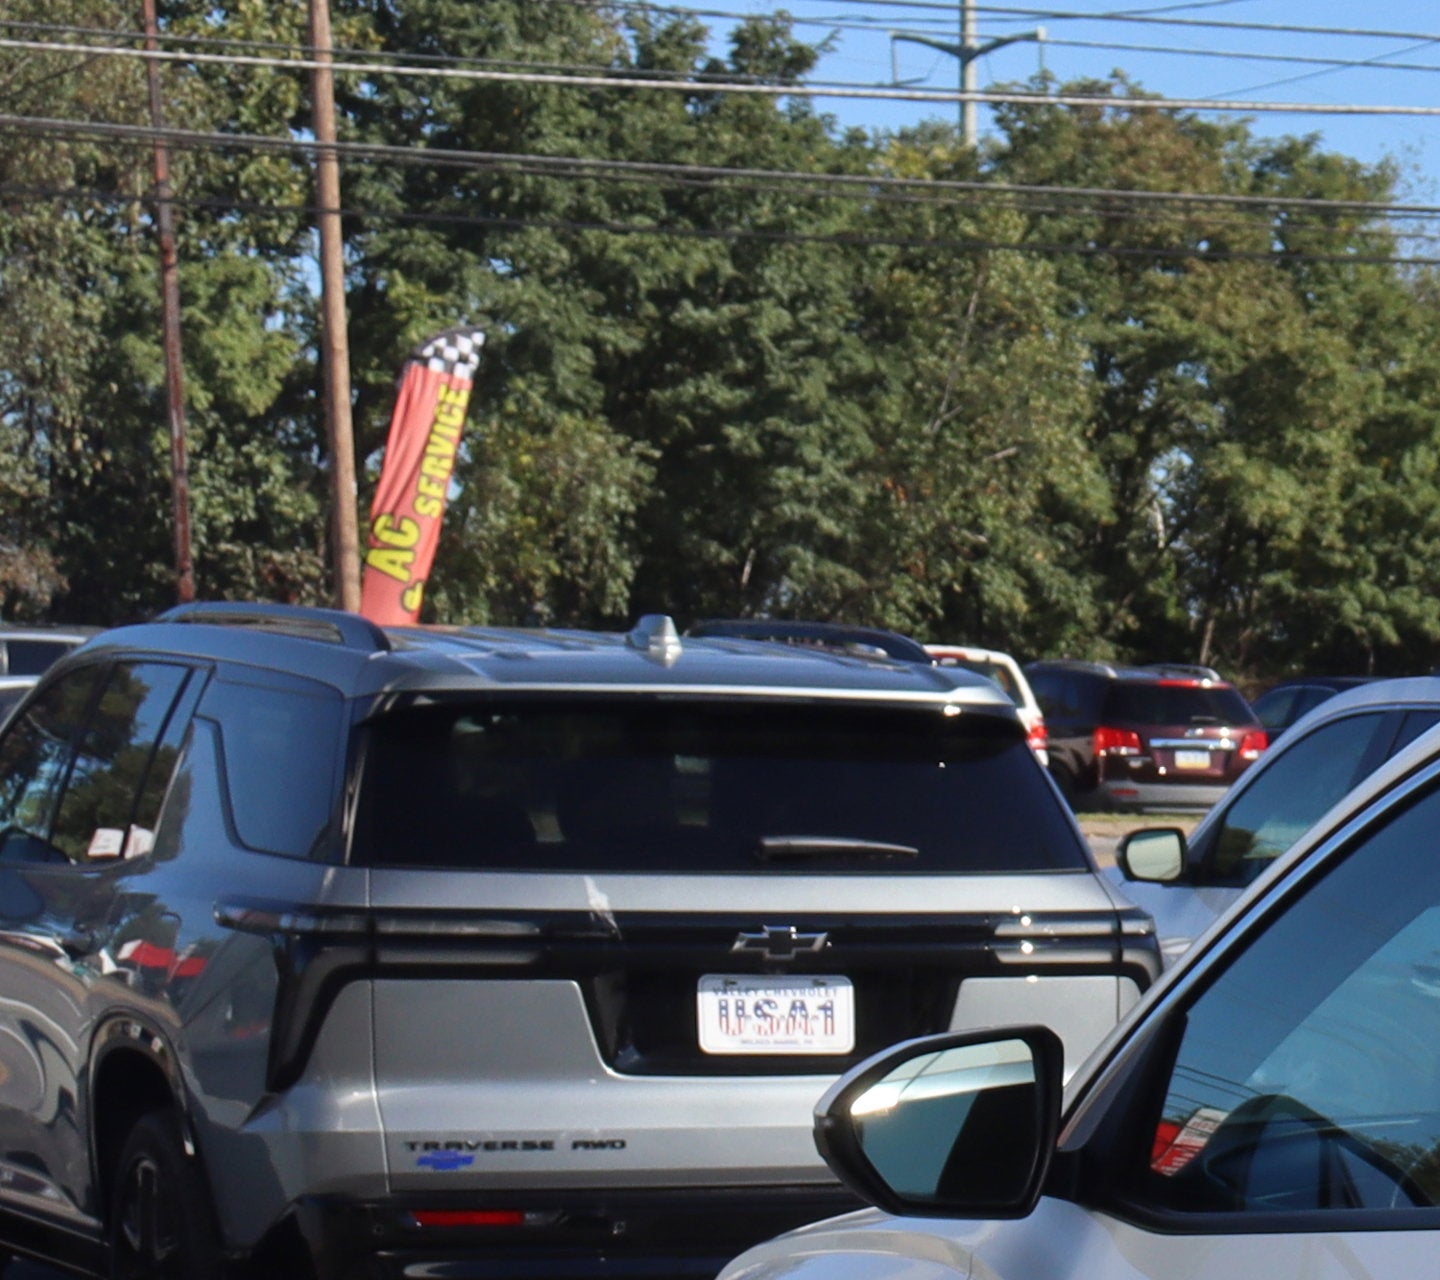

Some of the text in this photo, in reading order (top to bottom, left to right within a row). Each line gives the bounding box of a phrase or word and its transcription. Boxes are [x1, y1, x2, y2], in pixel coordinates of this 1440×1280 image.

[366, 514, 420, 582] AC
[414, 384, 472, 519] SERVICE
[404, 1139, 627, 1151] TRAVERSE AWD
